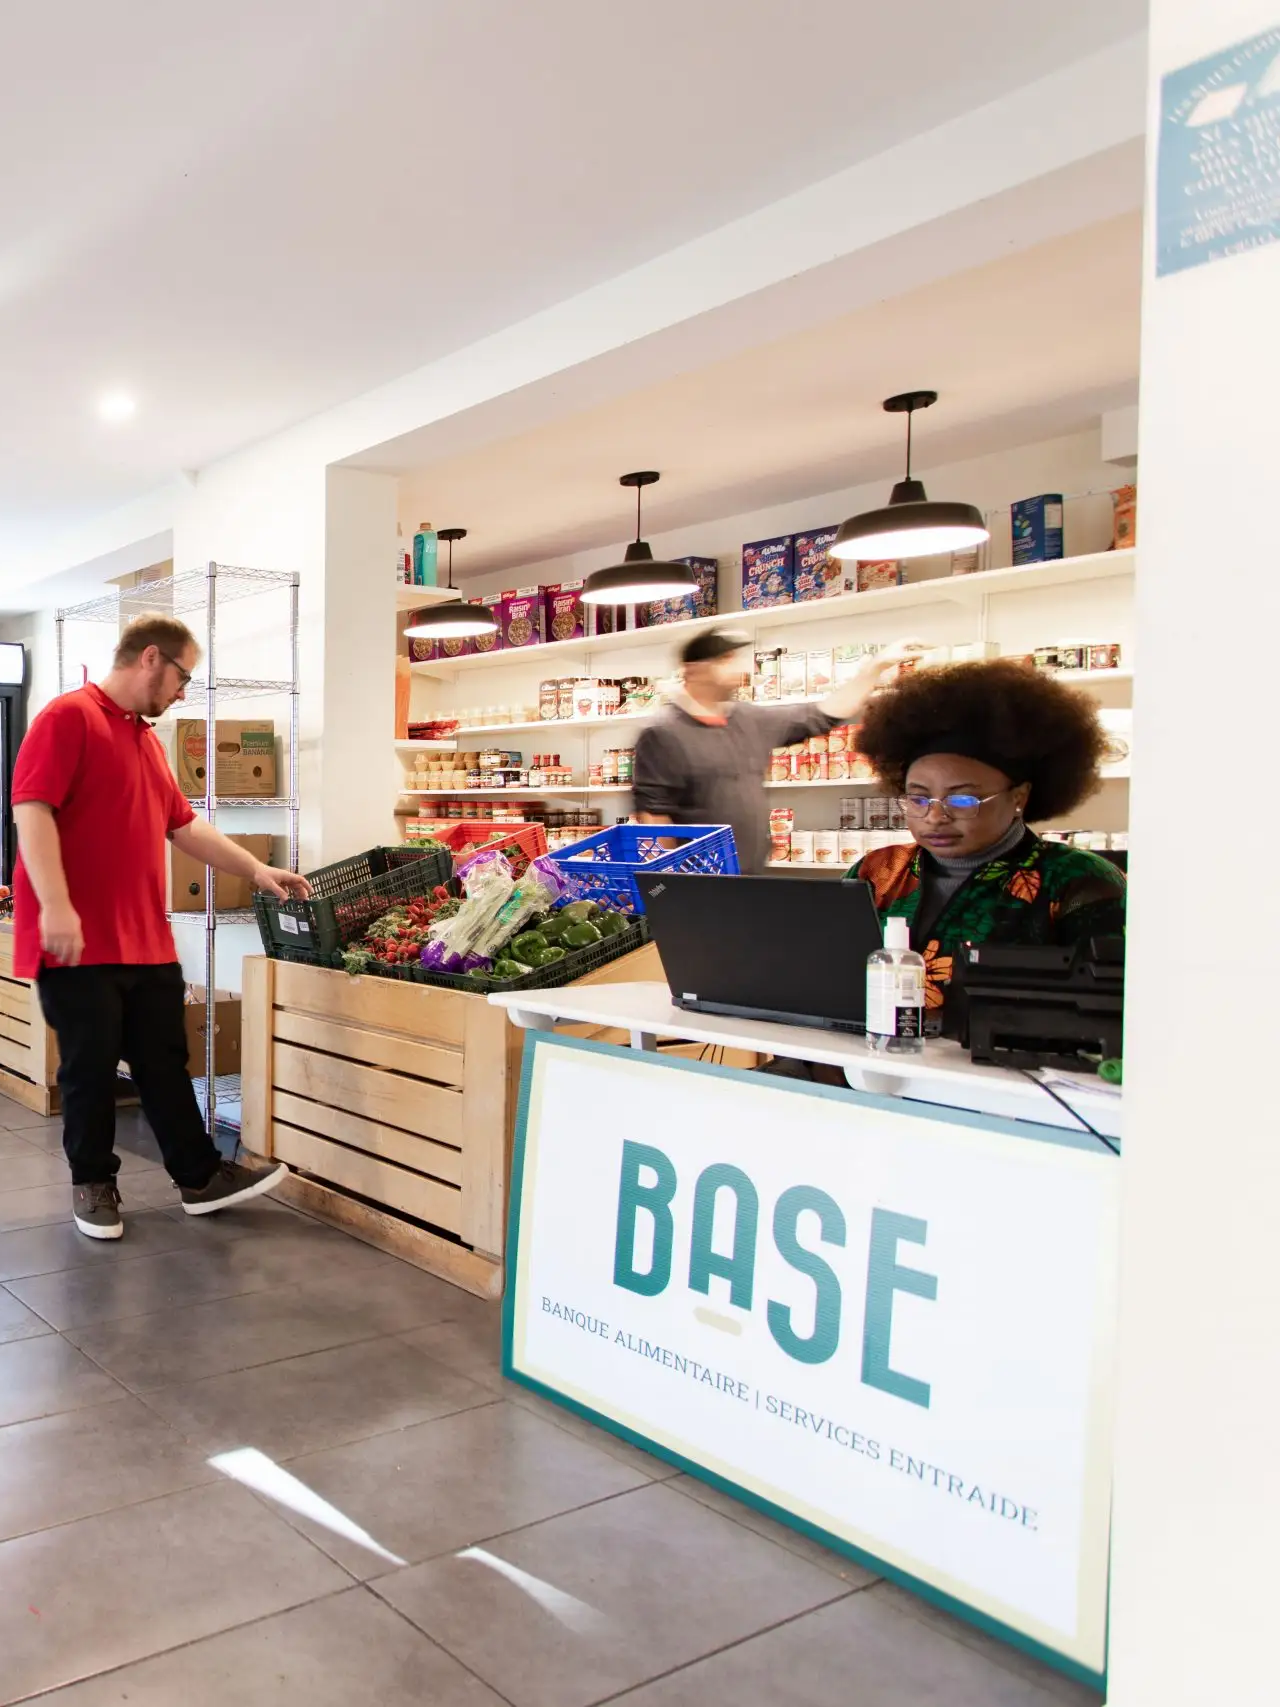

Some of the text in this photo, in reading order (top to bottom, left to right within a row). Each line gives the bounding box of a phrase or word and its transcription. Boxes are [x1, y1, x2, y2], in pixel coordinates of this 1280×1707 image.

[748, 556, 785, 576] CRUNCH
[801, 552, 826, 567] CRUN
[509, 604, 529, 614] Raisin
[553, 599, 573, 609] Raisin
[511, 611, 527, 620] Bran
[612, 1138, 938, 1410] BASE
[541, 1296, 610, 1340] BANQUE
[613, 1329, 750, 1403] ALIMENTAIRE
[765, 1394, 881, 1461] SERVICES
[888, 1449, 1040, 1533] ENTRAIDE
